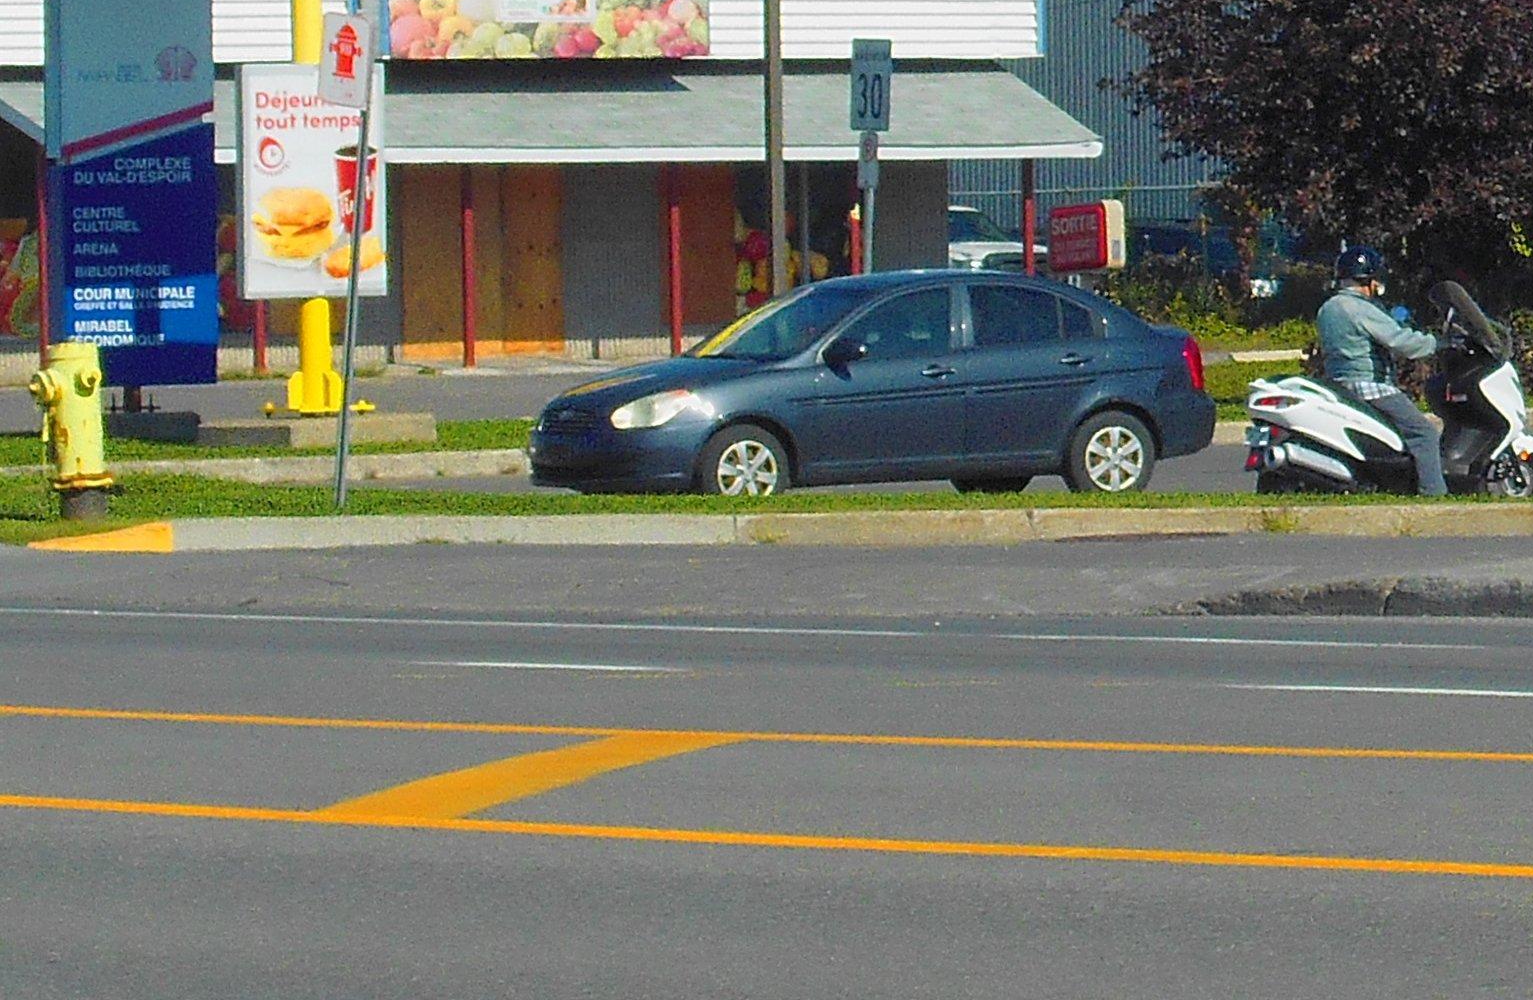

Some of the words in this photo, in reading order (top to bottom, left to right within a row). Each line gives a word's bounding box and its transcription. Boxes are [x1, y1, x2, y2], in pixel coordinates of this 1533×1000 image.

[857, 72, 883, 119] 30
[255, 113, 297, 130] tout
[303, 113, 363, 131] temps
[114, 157, 192, 171] COMPLEXE
[74, 171, 94, 184] DU
[73, 206, 126, 219] CENTRE
[73, 220, 140, 233] CULTUREL
[74, 287, 112, 301] COUR
[115, 286, 196, 300] MUNICIPALE
[74, 319, 133, 333] MIRABEL
